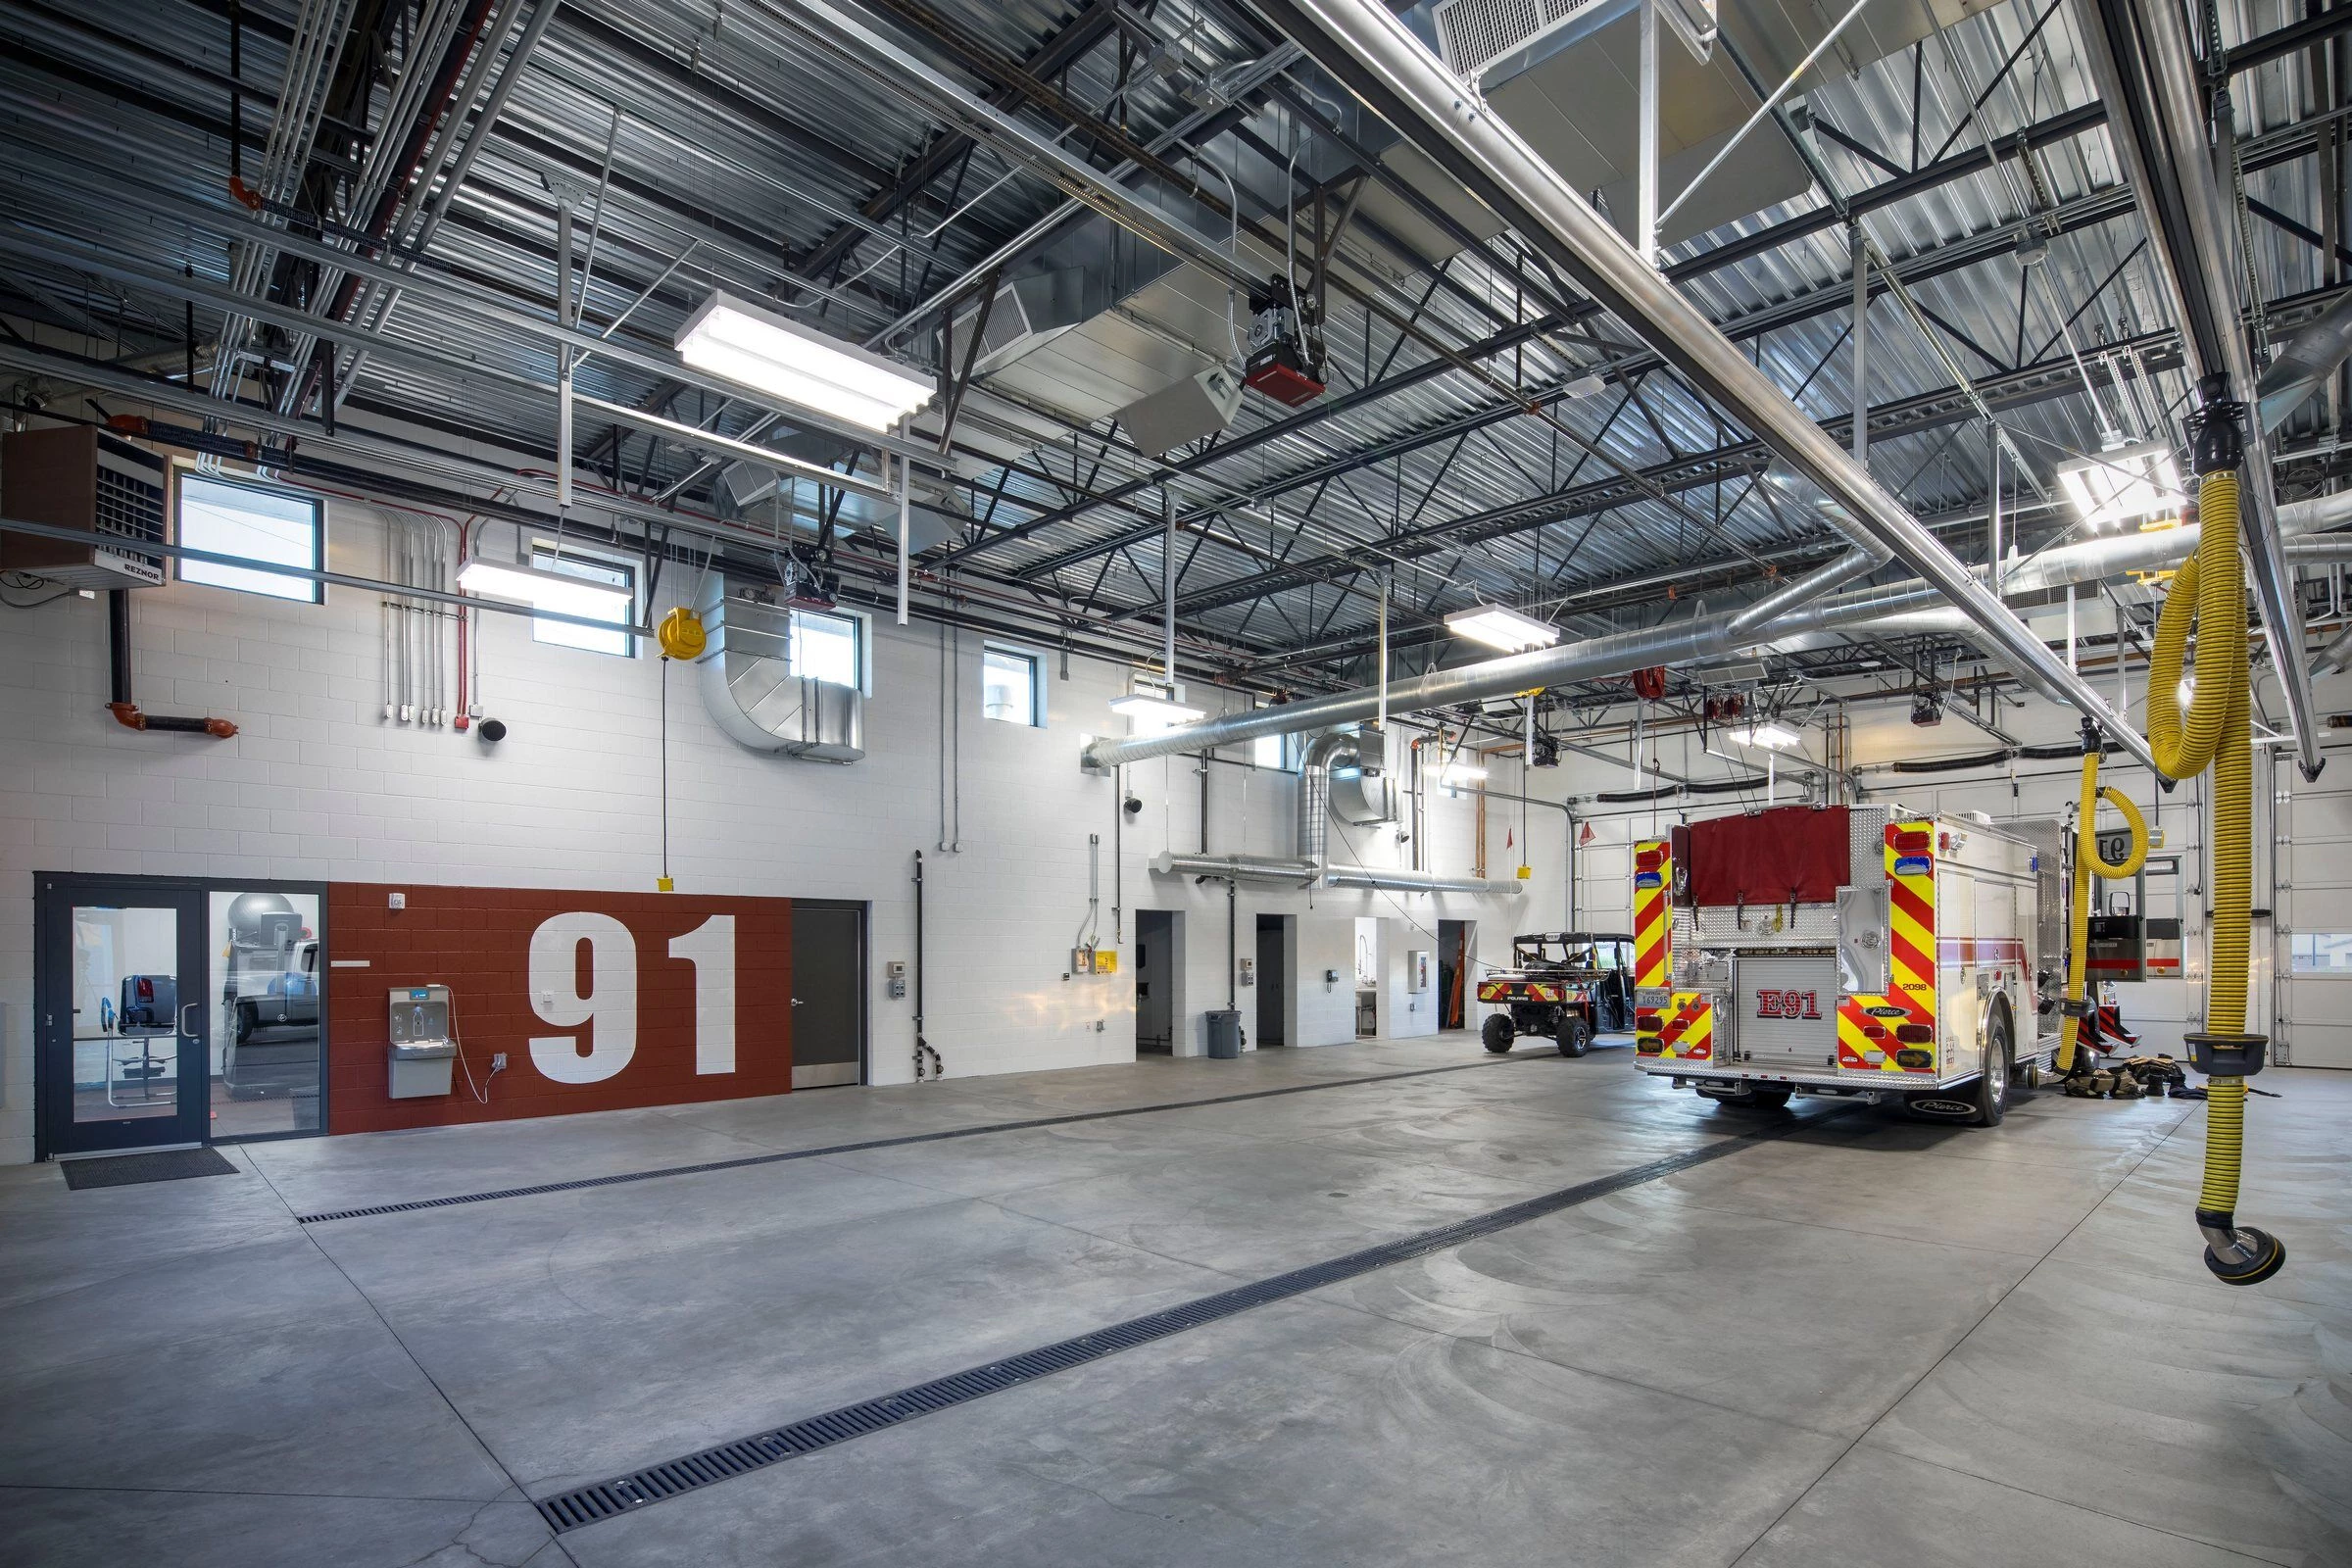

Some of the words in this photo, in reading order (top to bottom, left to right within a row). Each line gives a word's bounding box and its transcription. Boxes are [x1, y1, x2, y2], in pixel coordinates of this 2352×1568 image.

[123, 564, 160, 581] REZNOR
[529, 911, 735, 1084] 91
[1757, 990, 1822, 1020] E91
[1871, 1006, 1900, 1016] Pierce
[1923, 1101, 1964, 1111] Pierce
